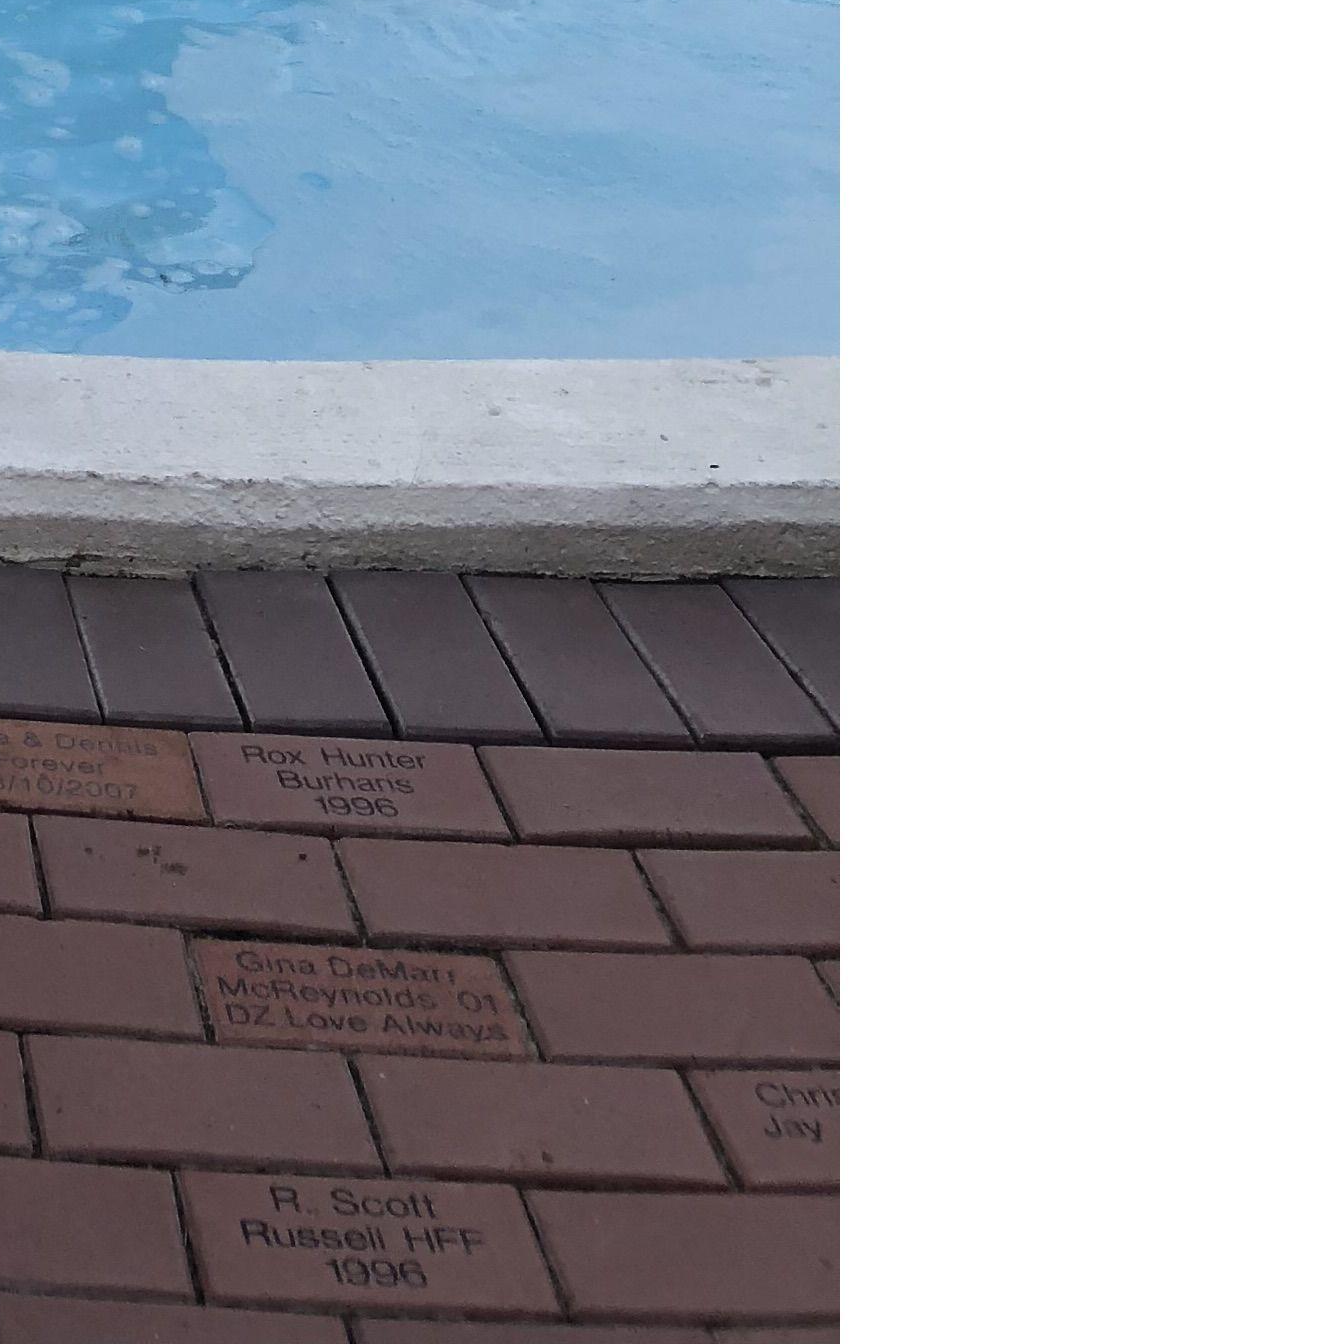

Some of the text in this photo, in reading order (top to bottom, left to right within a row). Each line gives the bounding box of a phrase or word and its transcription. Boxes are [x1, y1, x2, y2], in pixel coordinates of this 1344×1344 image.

[23, 731, 43, 748] &
[241, 744, 426, 770] Rox Hunter
[276, 769, 415, 794] Burhans
[313, 795, 399, 818] 1996
[236, 950, 314, 975] Gina
[225, 1003, 509, 1043] DZ Love Always
[330, 1186, 437, 1220] Scott
[240, 1217, 486, 1256] Russell HFF
[326, 1256, 429, 1289] 1996
